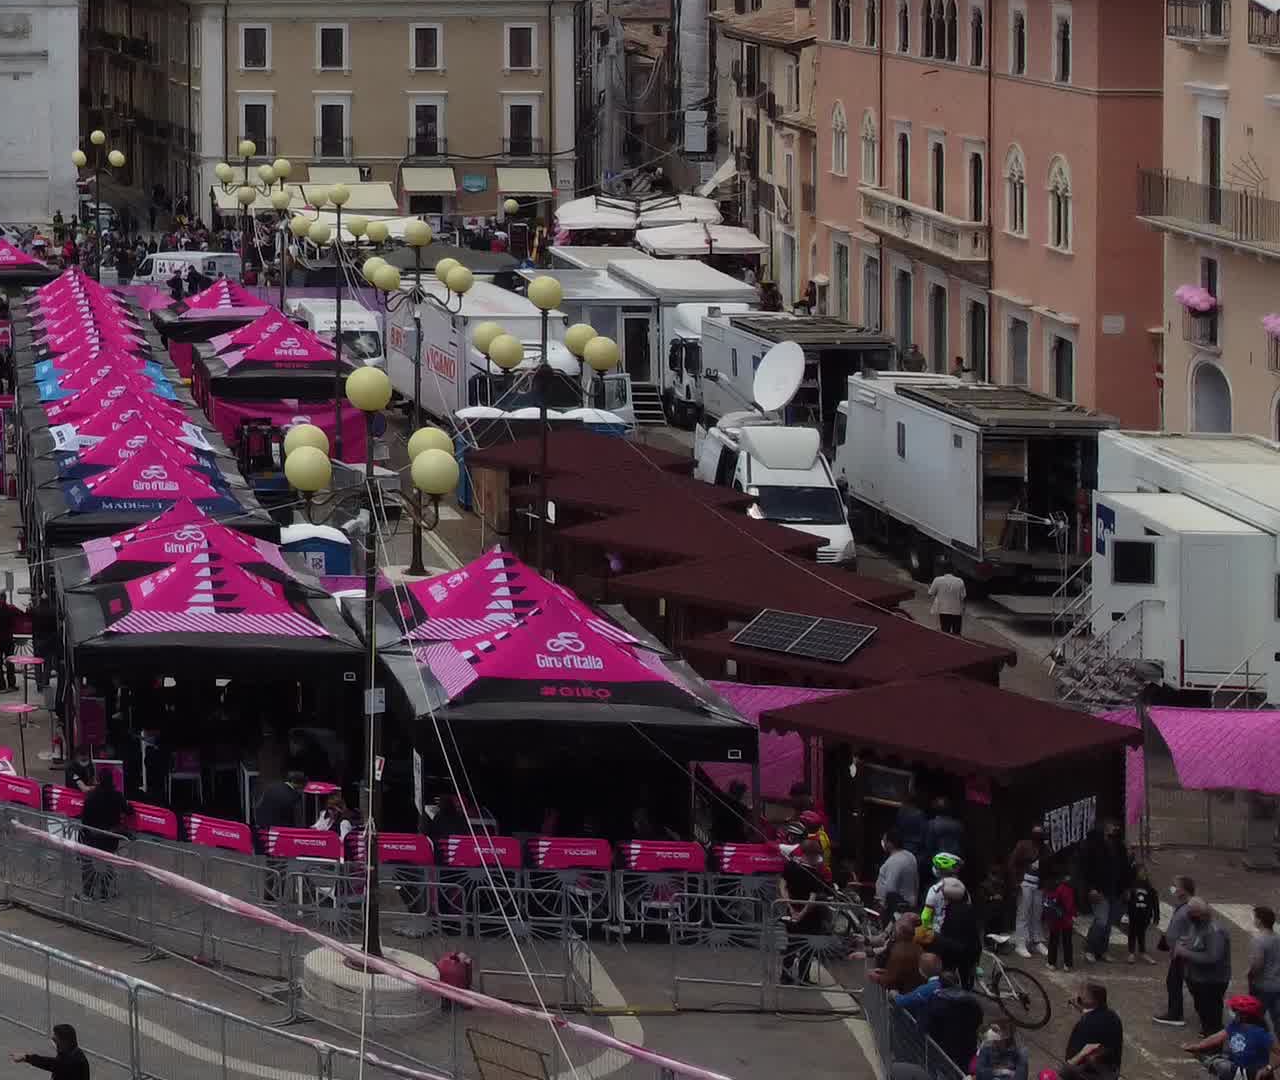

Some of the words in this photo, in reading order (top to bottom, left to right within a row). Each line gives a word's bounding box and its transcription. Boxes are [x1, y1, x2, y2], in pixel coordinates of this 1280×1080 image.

[132, 480, 150, 491] Giro
[164, 543, 185, 553] Giro
[536, 653, 562, 668] Giro
[563, 654, 604, 670] d'Italia
